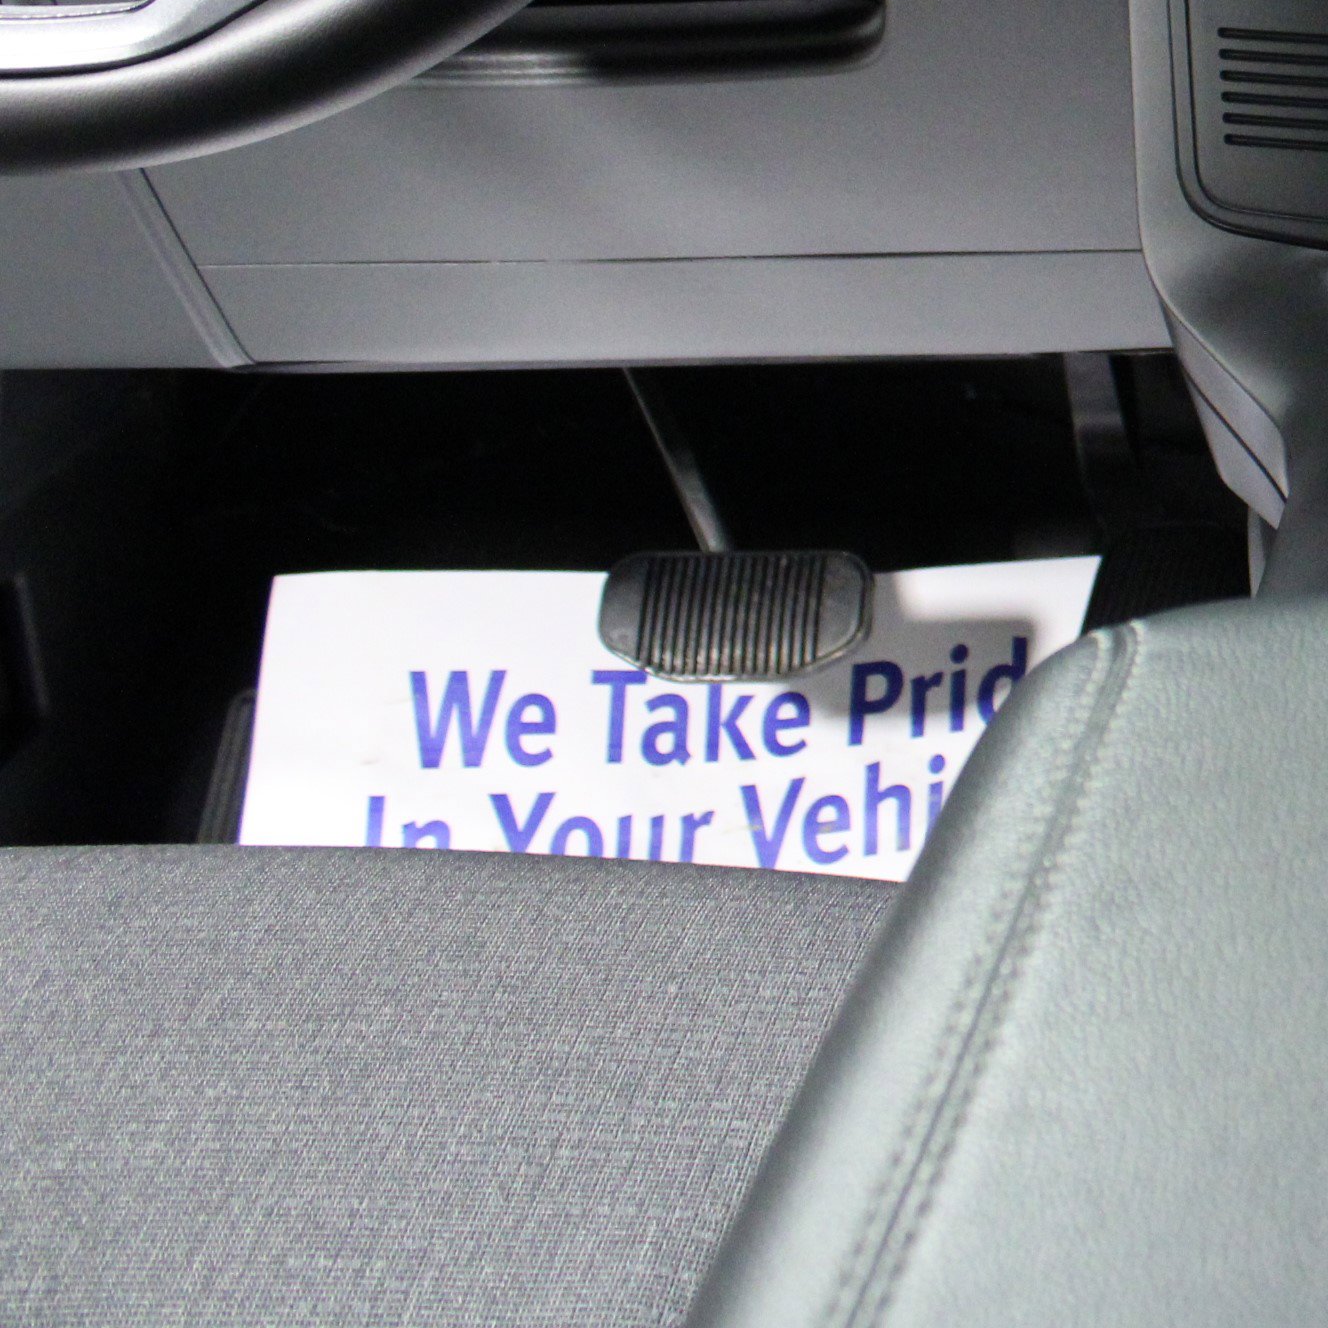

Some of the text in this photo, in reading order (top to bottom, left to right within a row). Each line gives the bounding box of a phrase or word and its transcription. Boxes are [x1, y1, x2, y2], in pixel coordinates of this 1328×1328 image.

[411, 637, 1029, 770] We Take Prid
[364, 795, 452, 850] In
